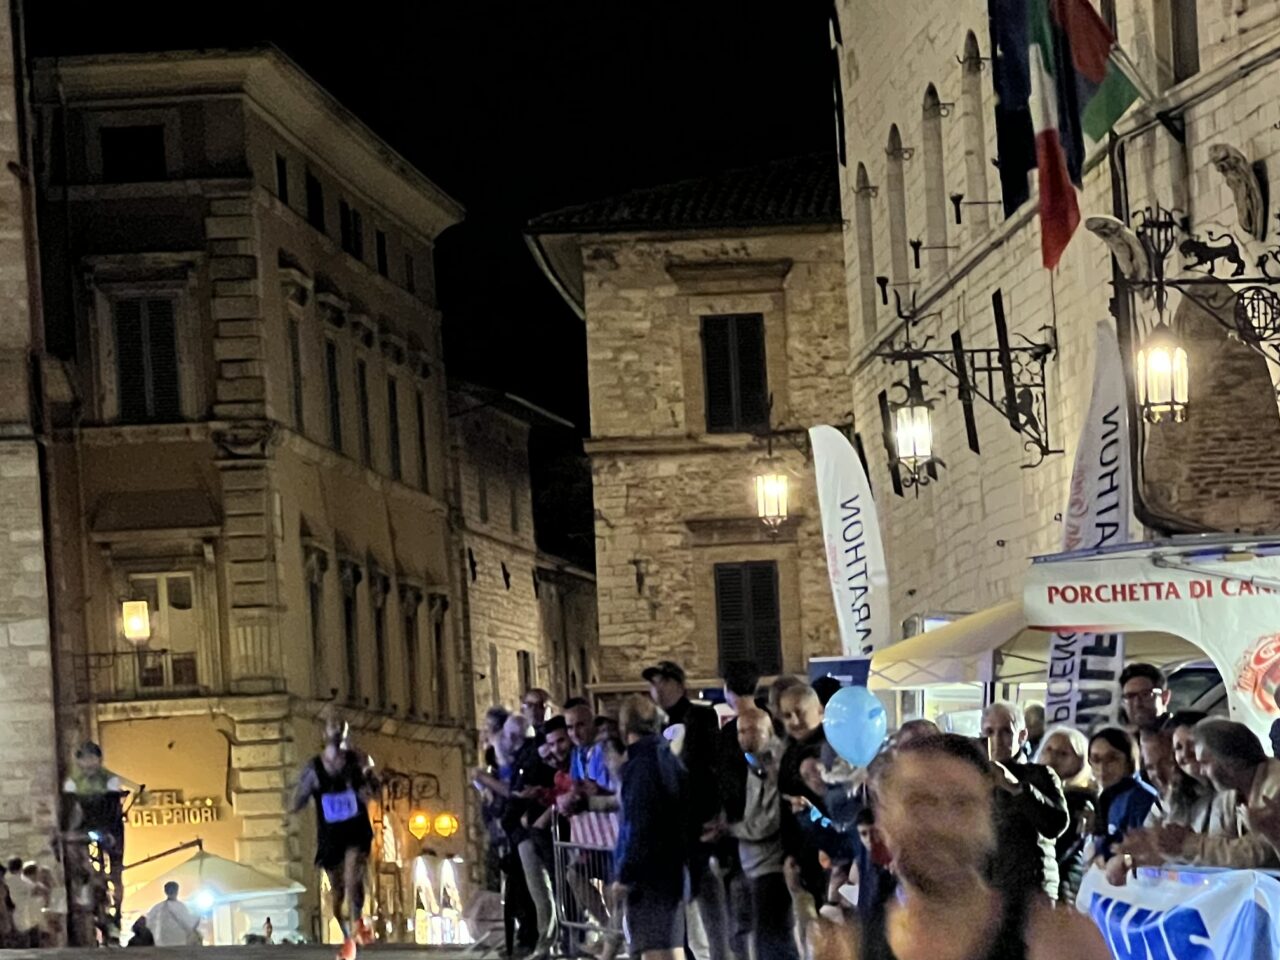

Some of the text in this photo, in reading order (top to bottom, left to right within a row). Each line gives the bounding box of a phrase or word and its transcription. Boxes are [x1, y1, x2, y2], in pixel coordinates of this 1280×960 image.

[1046, 581, 1182, 605] PORCHETTA
[1189, 579, 1213, 599] DI
[160, 805, 218, 826] PRIORI
